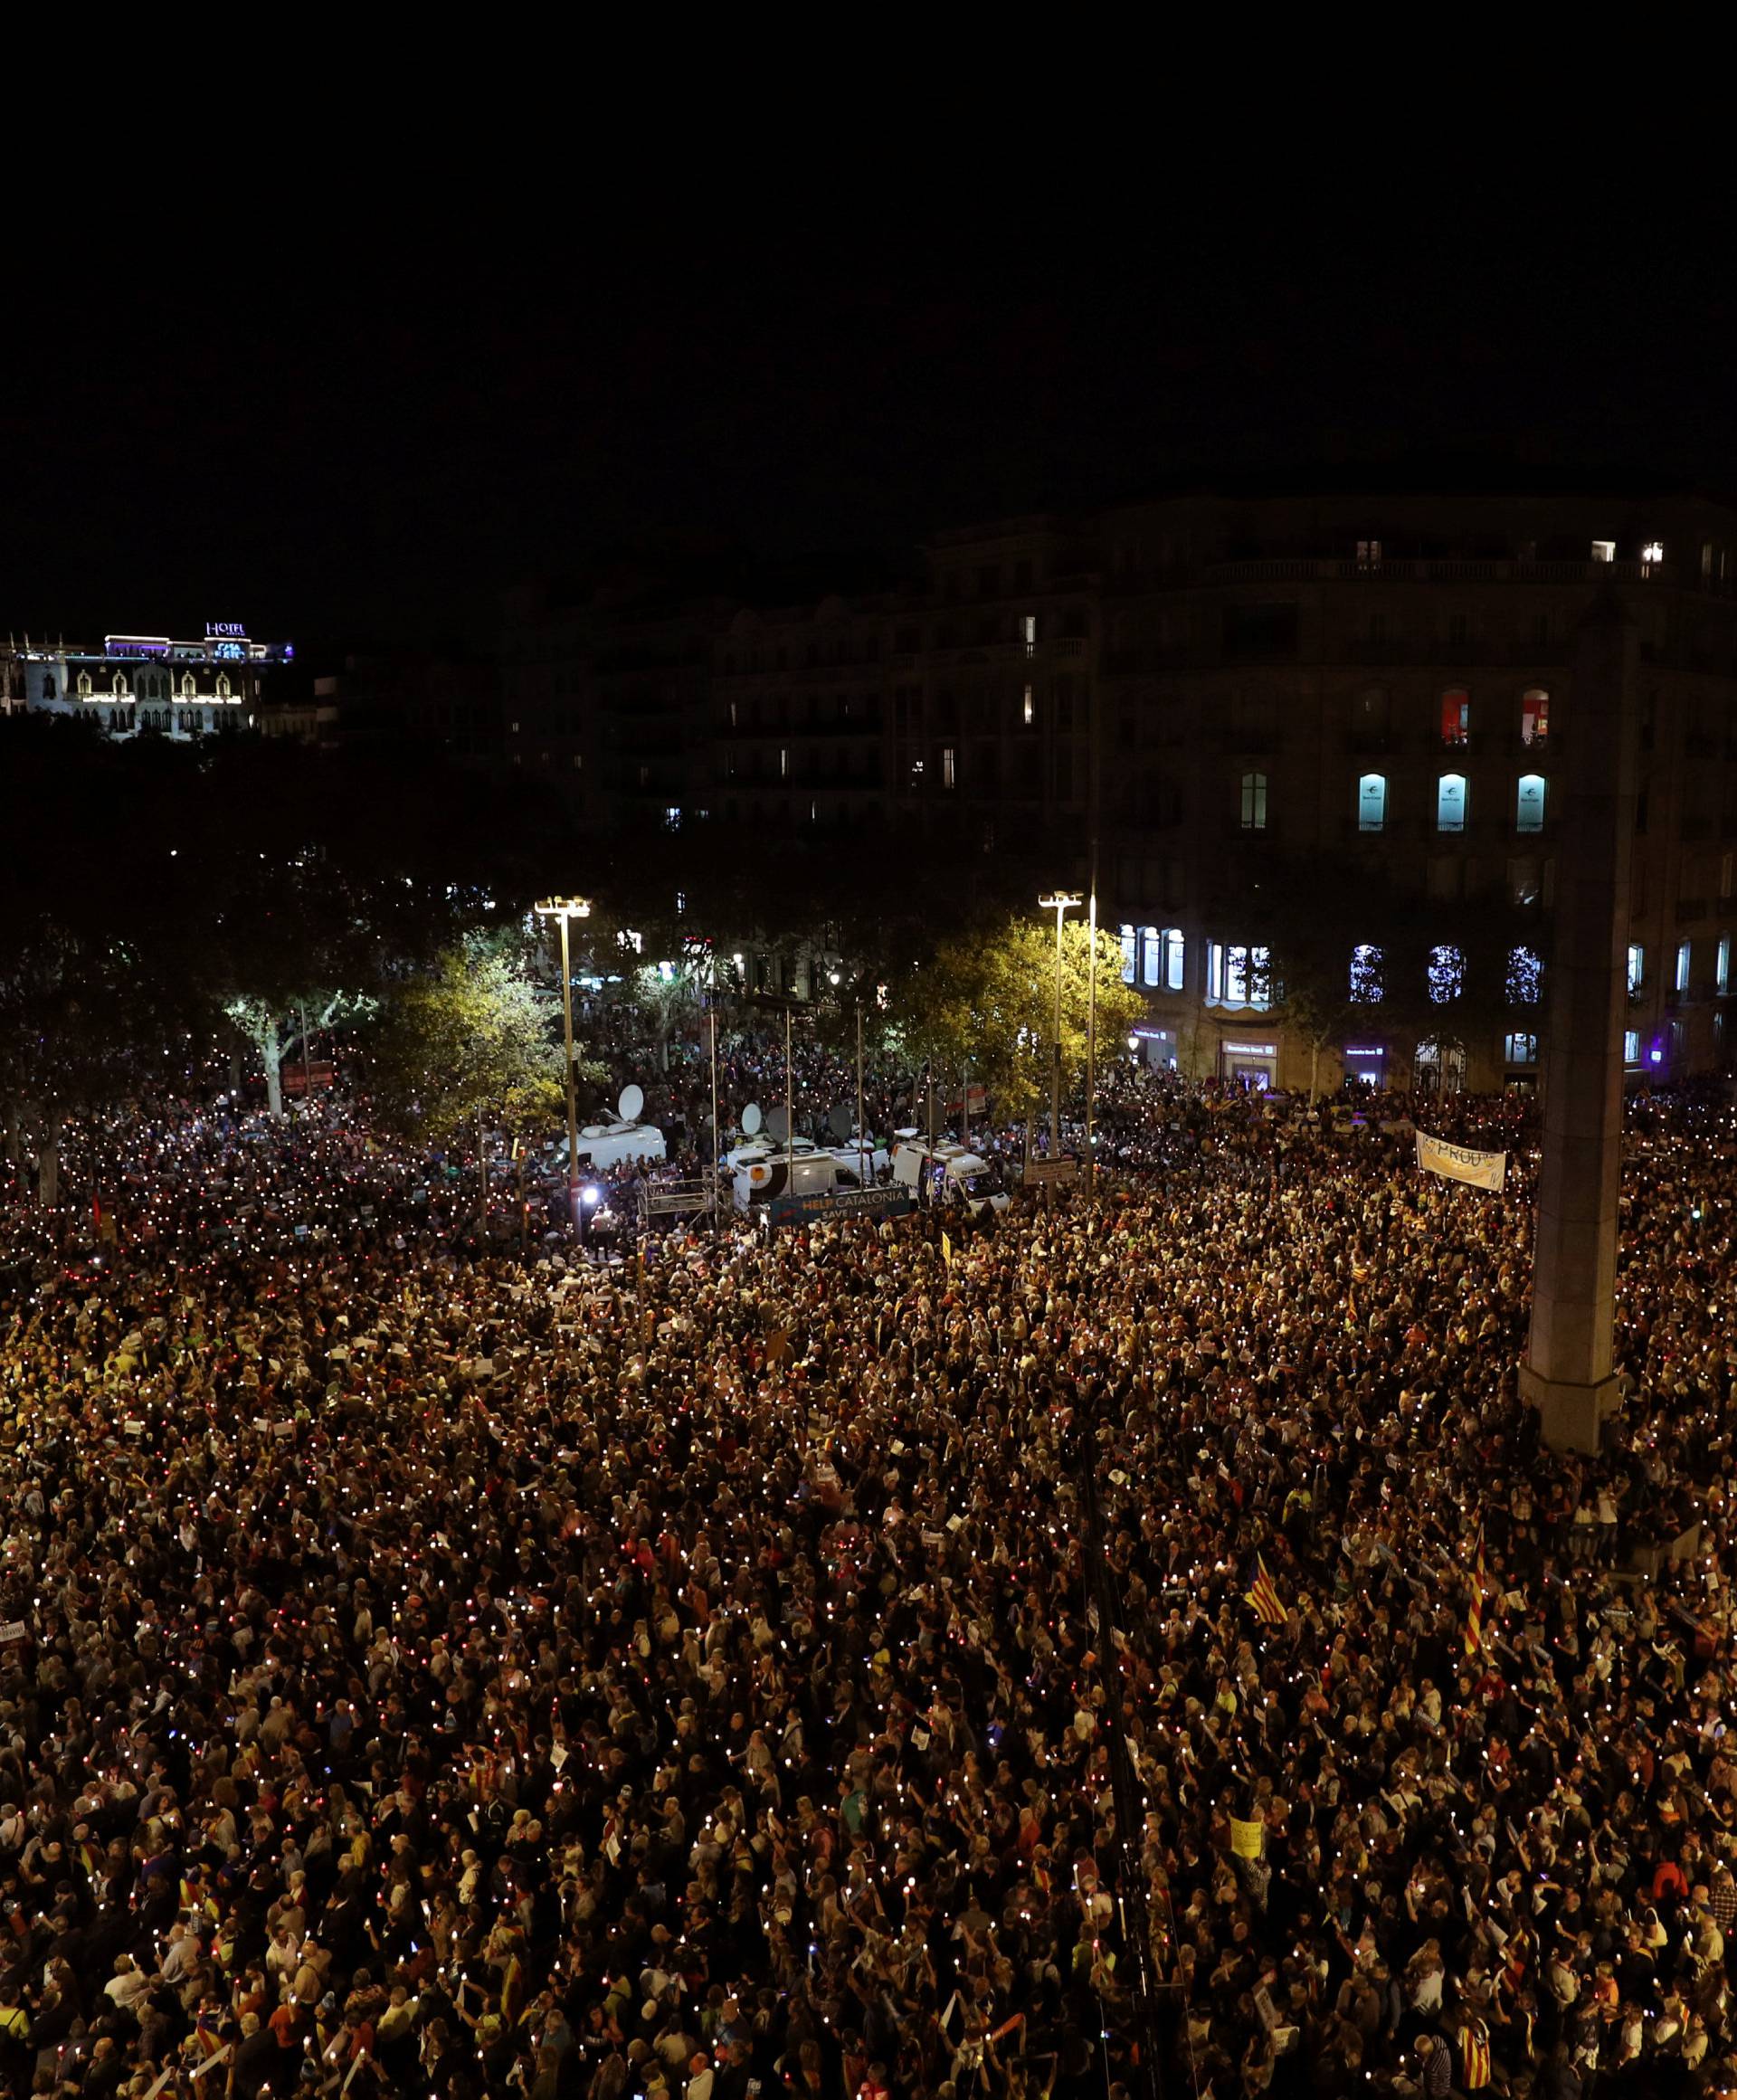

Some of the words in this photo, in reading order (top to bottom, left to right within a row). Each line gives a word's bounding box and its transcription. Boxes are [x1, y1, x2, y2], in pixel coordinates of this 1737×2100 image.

[206, 622, 245, 636] HOTEL
[802, 1198, 834, 1212] HELP
[837, 1190, 906, 1209] CATALONIA
[821, 1211, 848, 1221] SAVE
